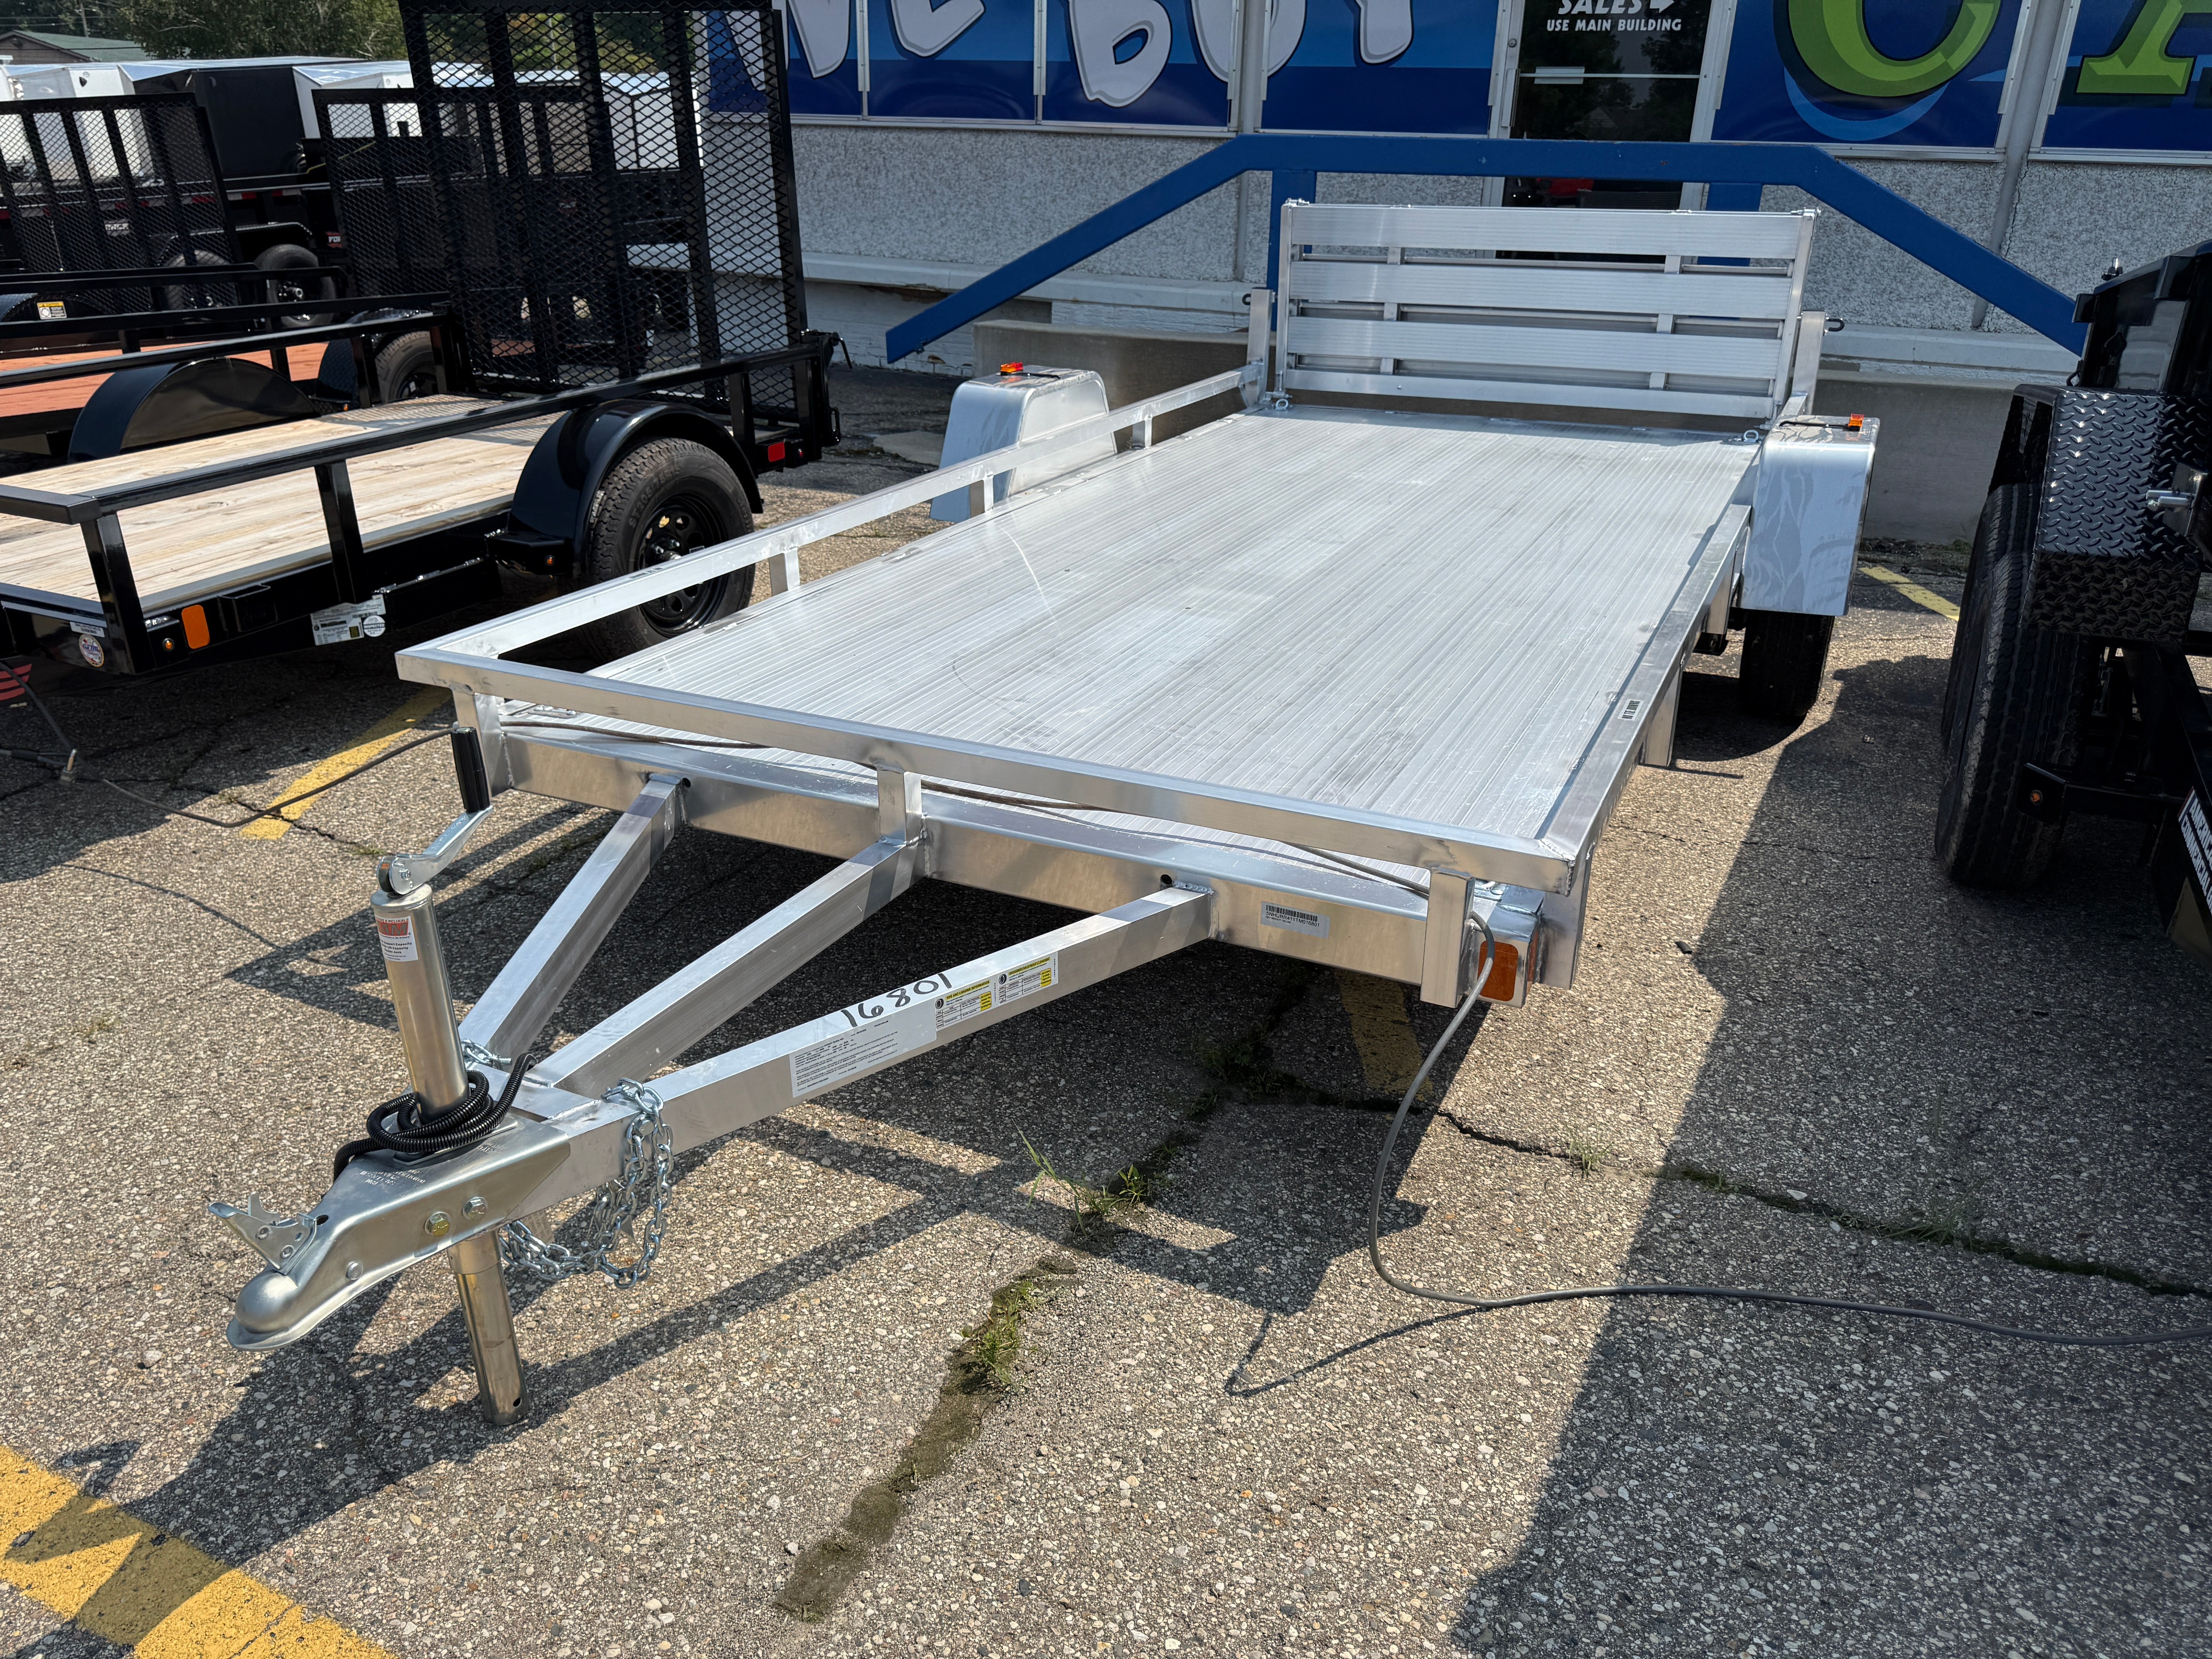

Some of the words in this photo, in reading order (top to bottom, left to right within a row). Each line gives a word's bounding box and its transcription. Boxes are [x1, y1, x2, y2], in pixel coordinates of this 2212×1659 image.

[1546, 19, 1570, 32] USE
[1575, 19, 1612, 31] MAIN
[1617, 19, 1682, 31] BUILDING
[2181, 814, 2210, 897] COMMERCIAL
[840, 973, 952, 1028] 16801
